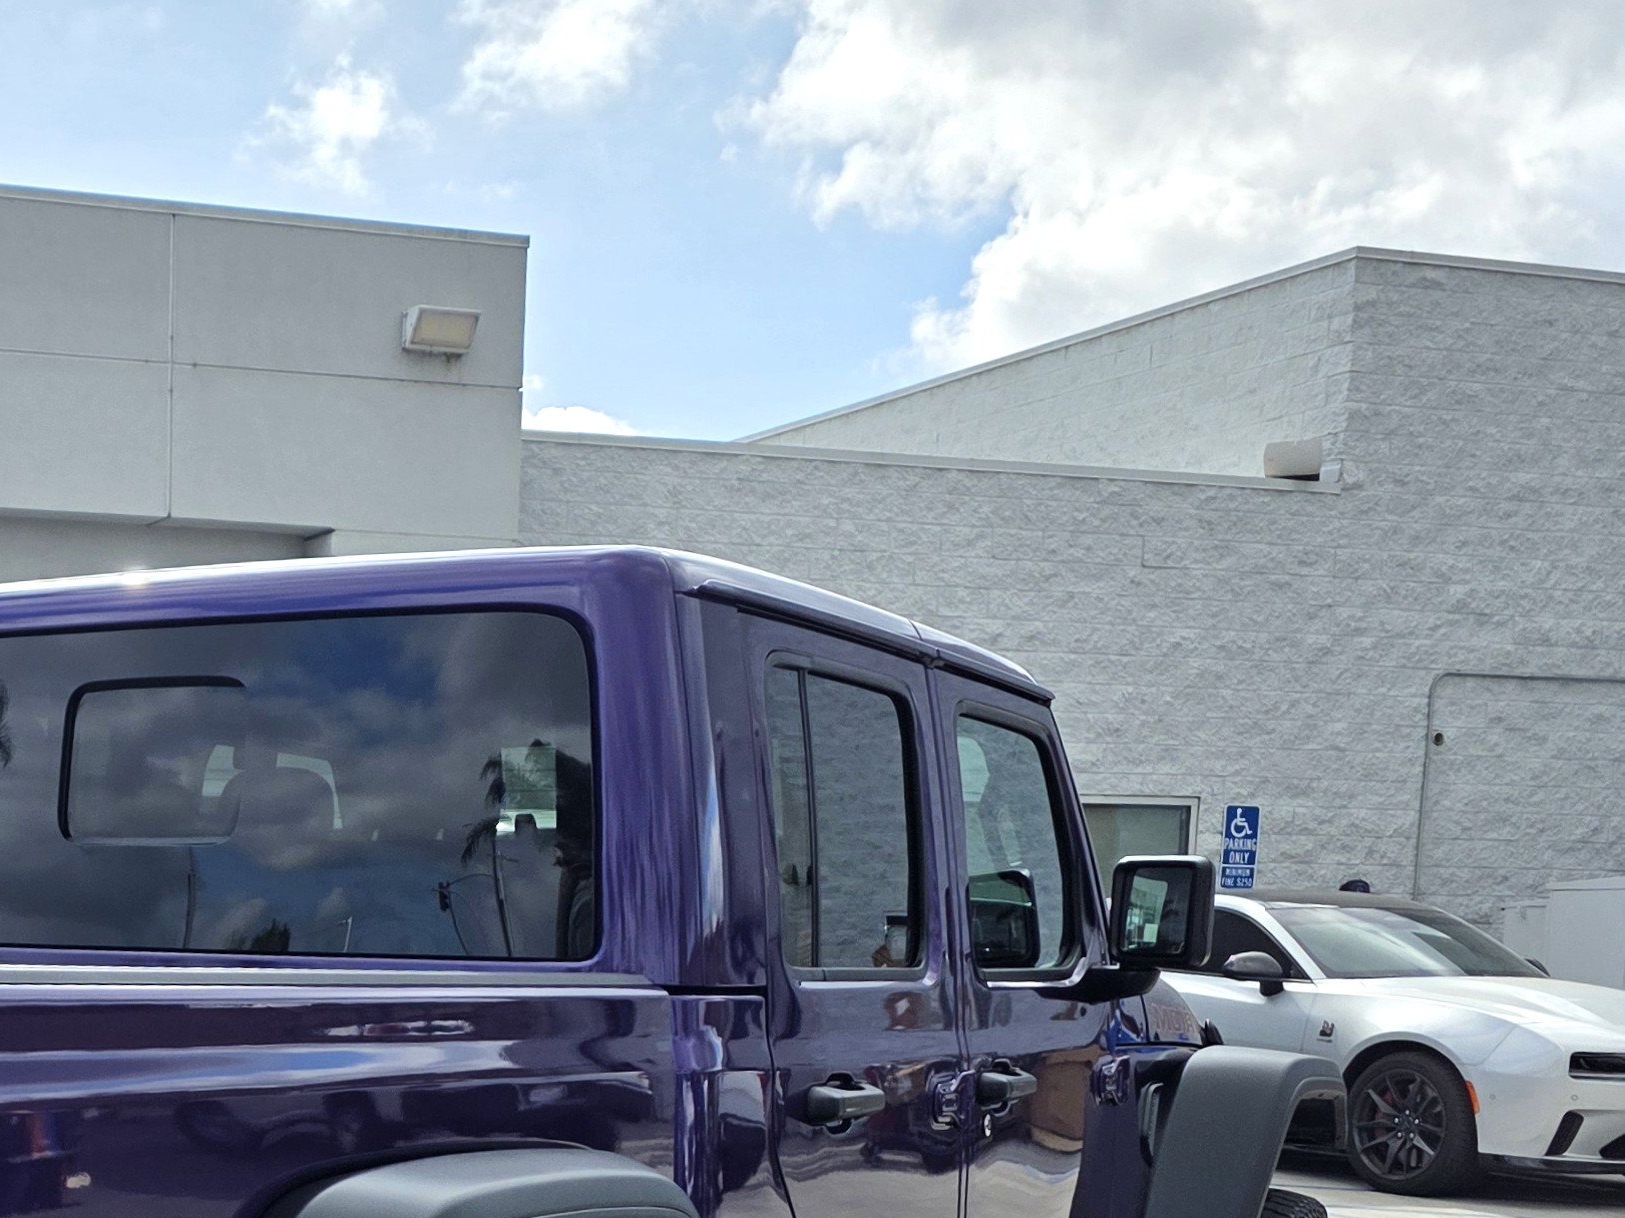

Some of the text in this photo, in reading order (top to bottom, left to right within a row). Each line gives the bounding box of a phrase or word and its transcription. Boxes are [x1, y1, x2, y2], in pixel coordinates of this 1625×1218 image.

[1224, 837, 1257, 852] PARKING
[1229, 851, 1250, 864] ONLY
[1221, 876, 1235, 887] FINE
